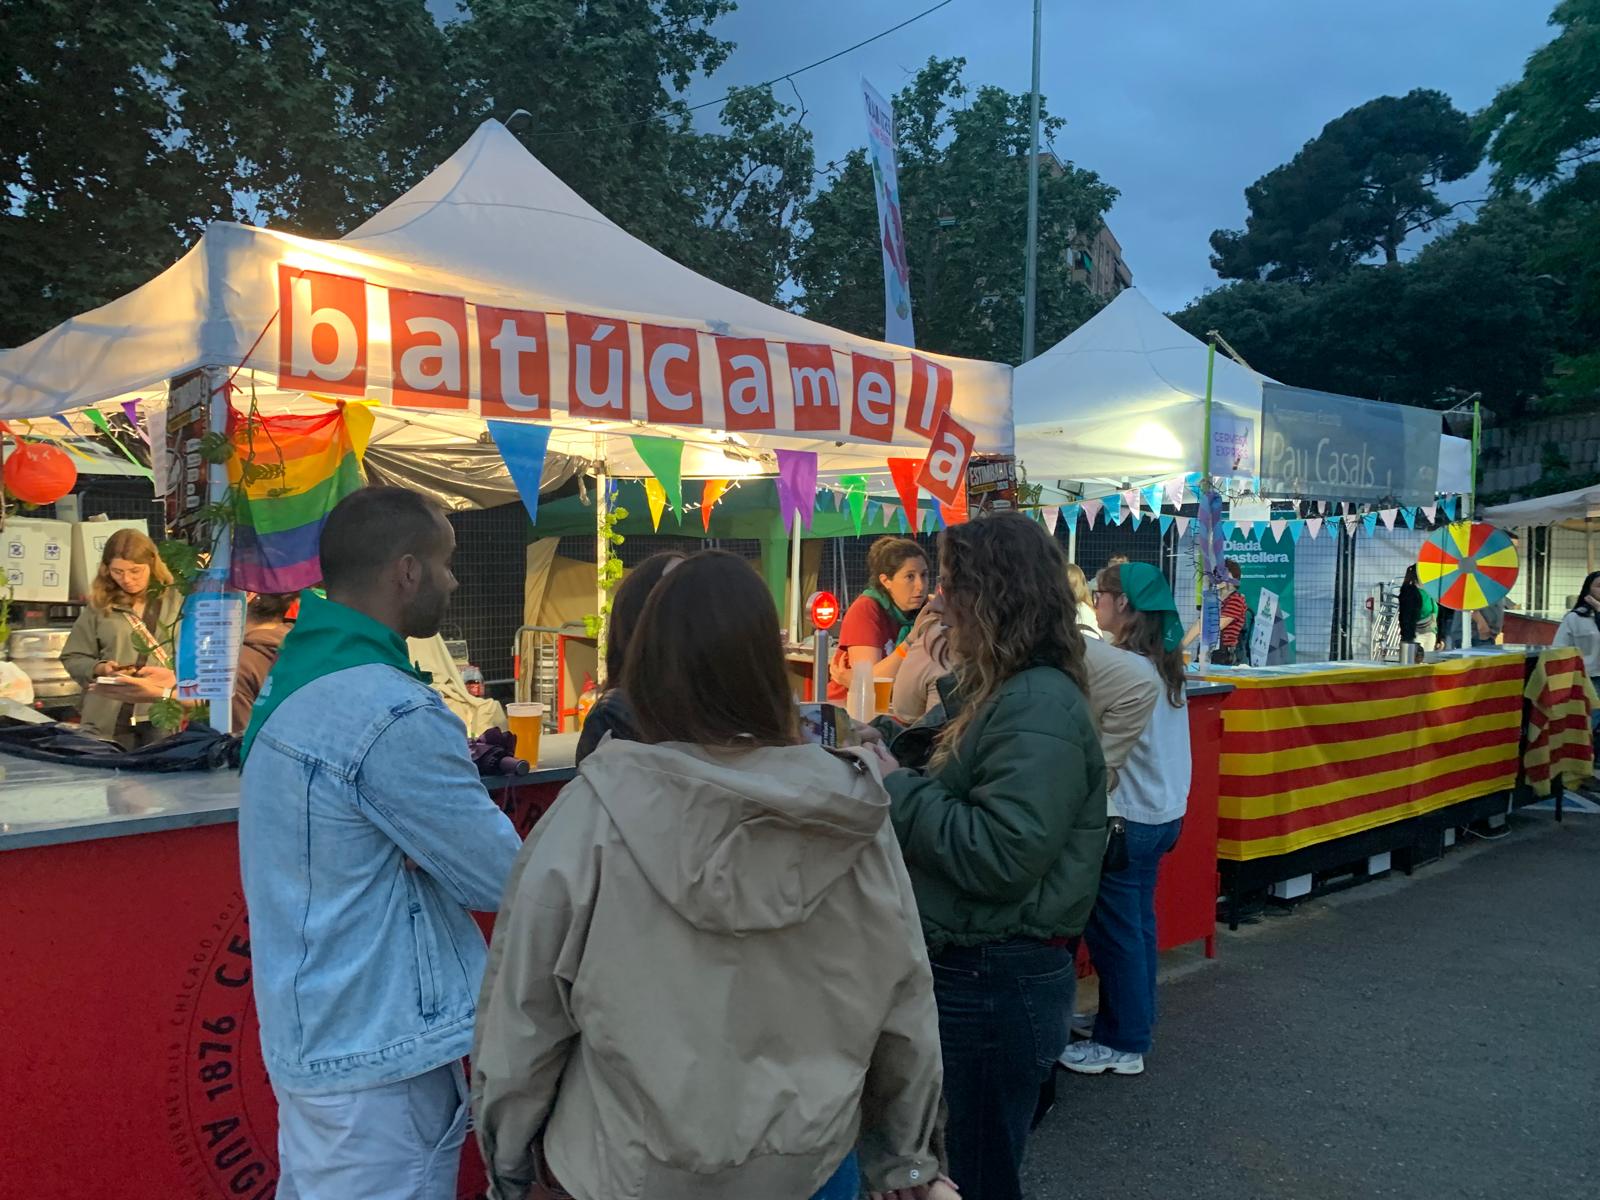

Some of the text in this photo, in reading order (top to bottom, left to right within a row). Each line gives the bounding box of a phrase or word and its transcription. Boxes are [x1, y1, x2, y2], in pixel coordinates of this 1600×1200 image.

[1268, 431, 1375, 489] Pau Casals
[1223, 540, 1262, 551] Diada
[169, 939, 214, 1027] CHICAGO
[198, 1015, 237, 1102] 1876
